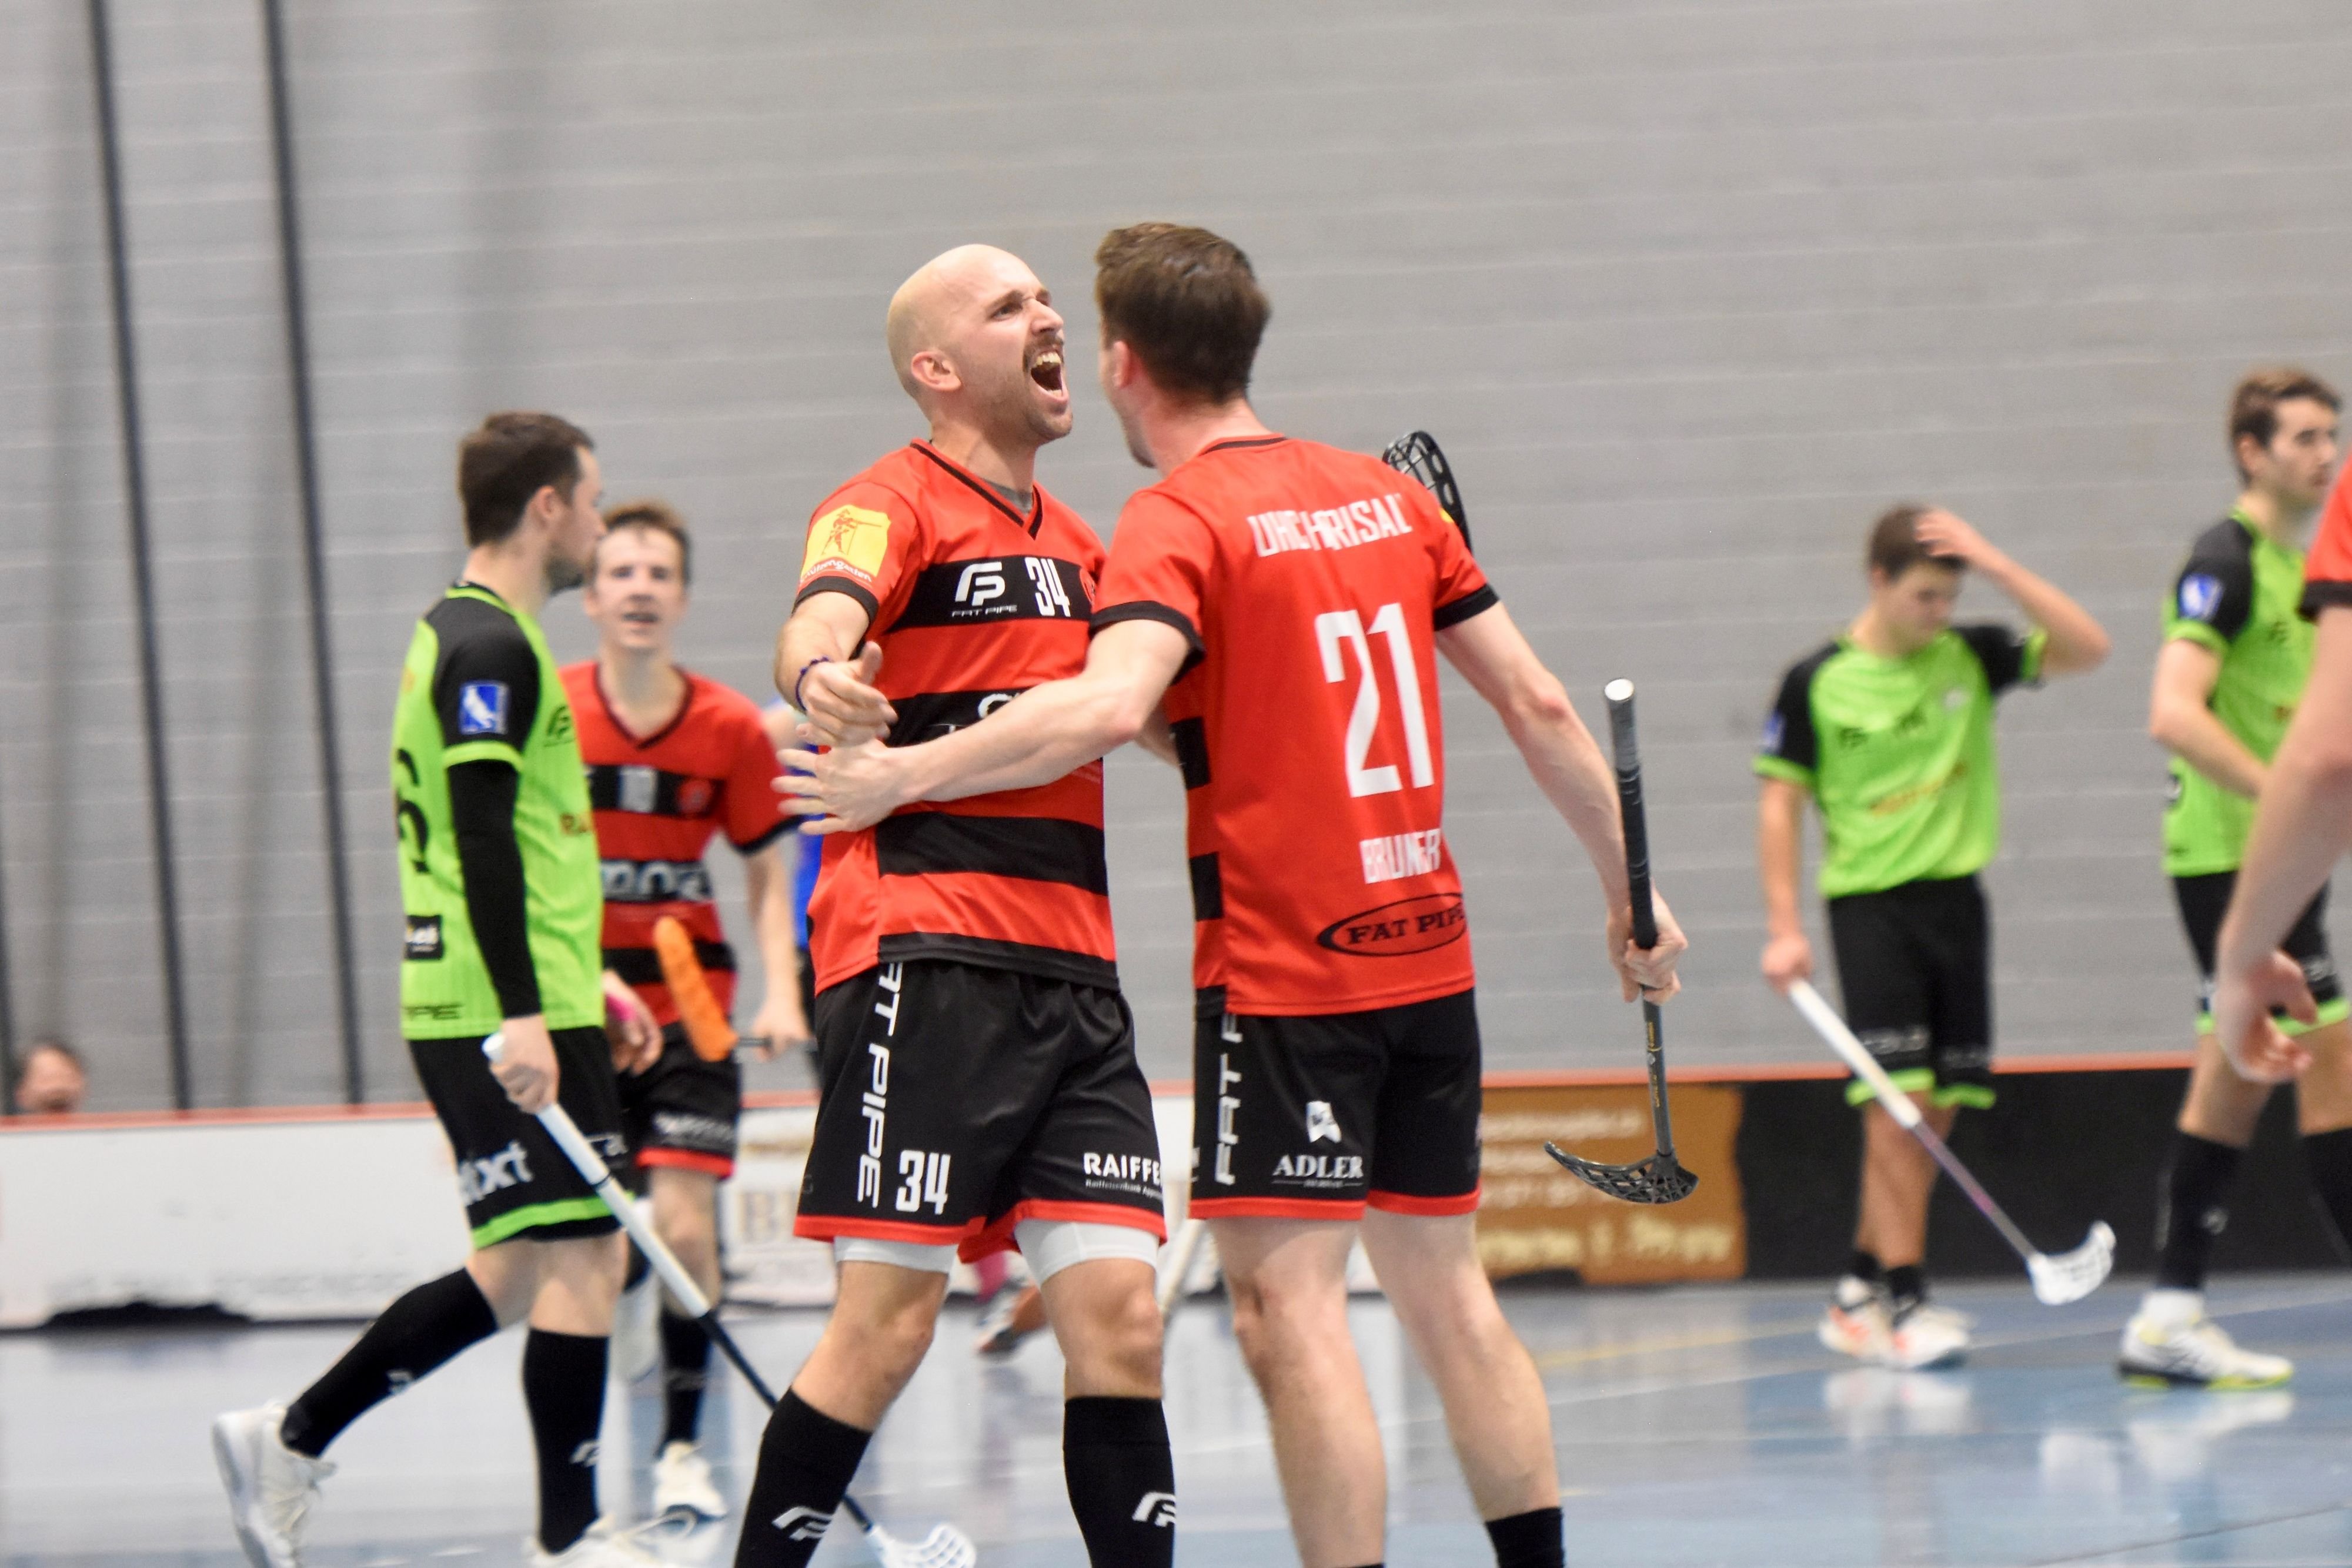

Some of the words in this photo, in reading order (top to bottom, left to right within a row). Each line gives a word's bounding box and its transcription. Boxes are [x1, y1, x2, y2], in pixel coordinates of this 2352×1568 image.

[952, 609, 982, 617] FAT
[985, 604, 1018, 614] PIPE
[1024, 557, 1071, 617] 34
[1314, 601, 1435, 798] 21
[1359, 828, 1441, 884] BRUNER
[1346, 920, 1407, 945] FAT
[857, 1043, 890, 1209] PIPE
[1215, 1052, 1242, 1185] FAT
[896, 1149, 951, 1215] 34
[1272, 1154, 1364, 1179] ADLER
